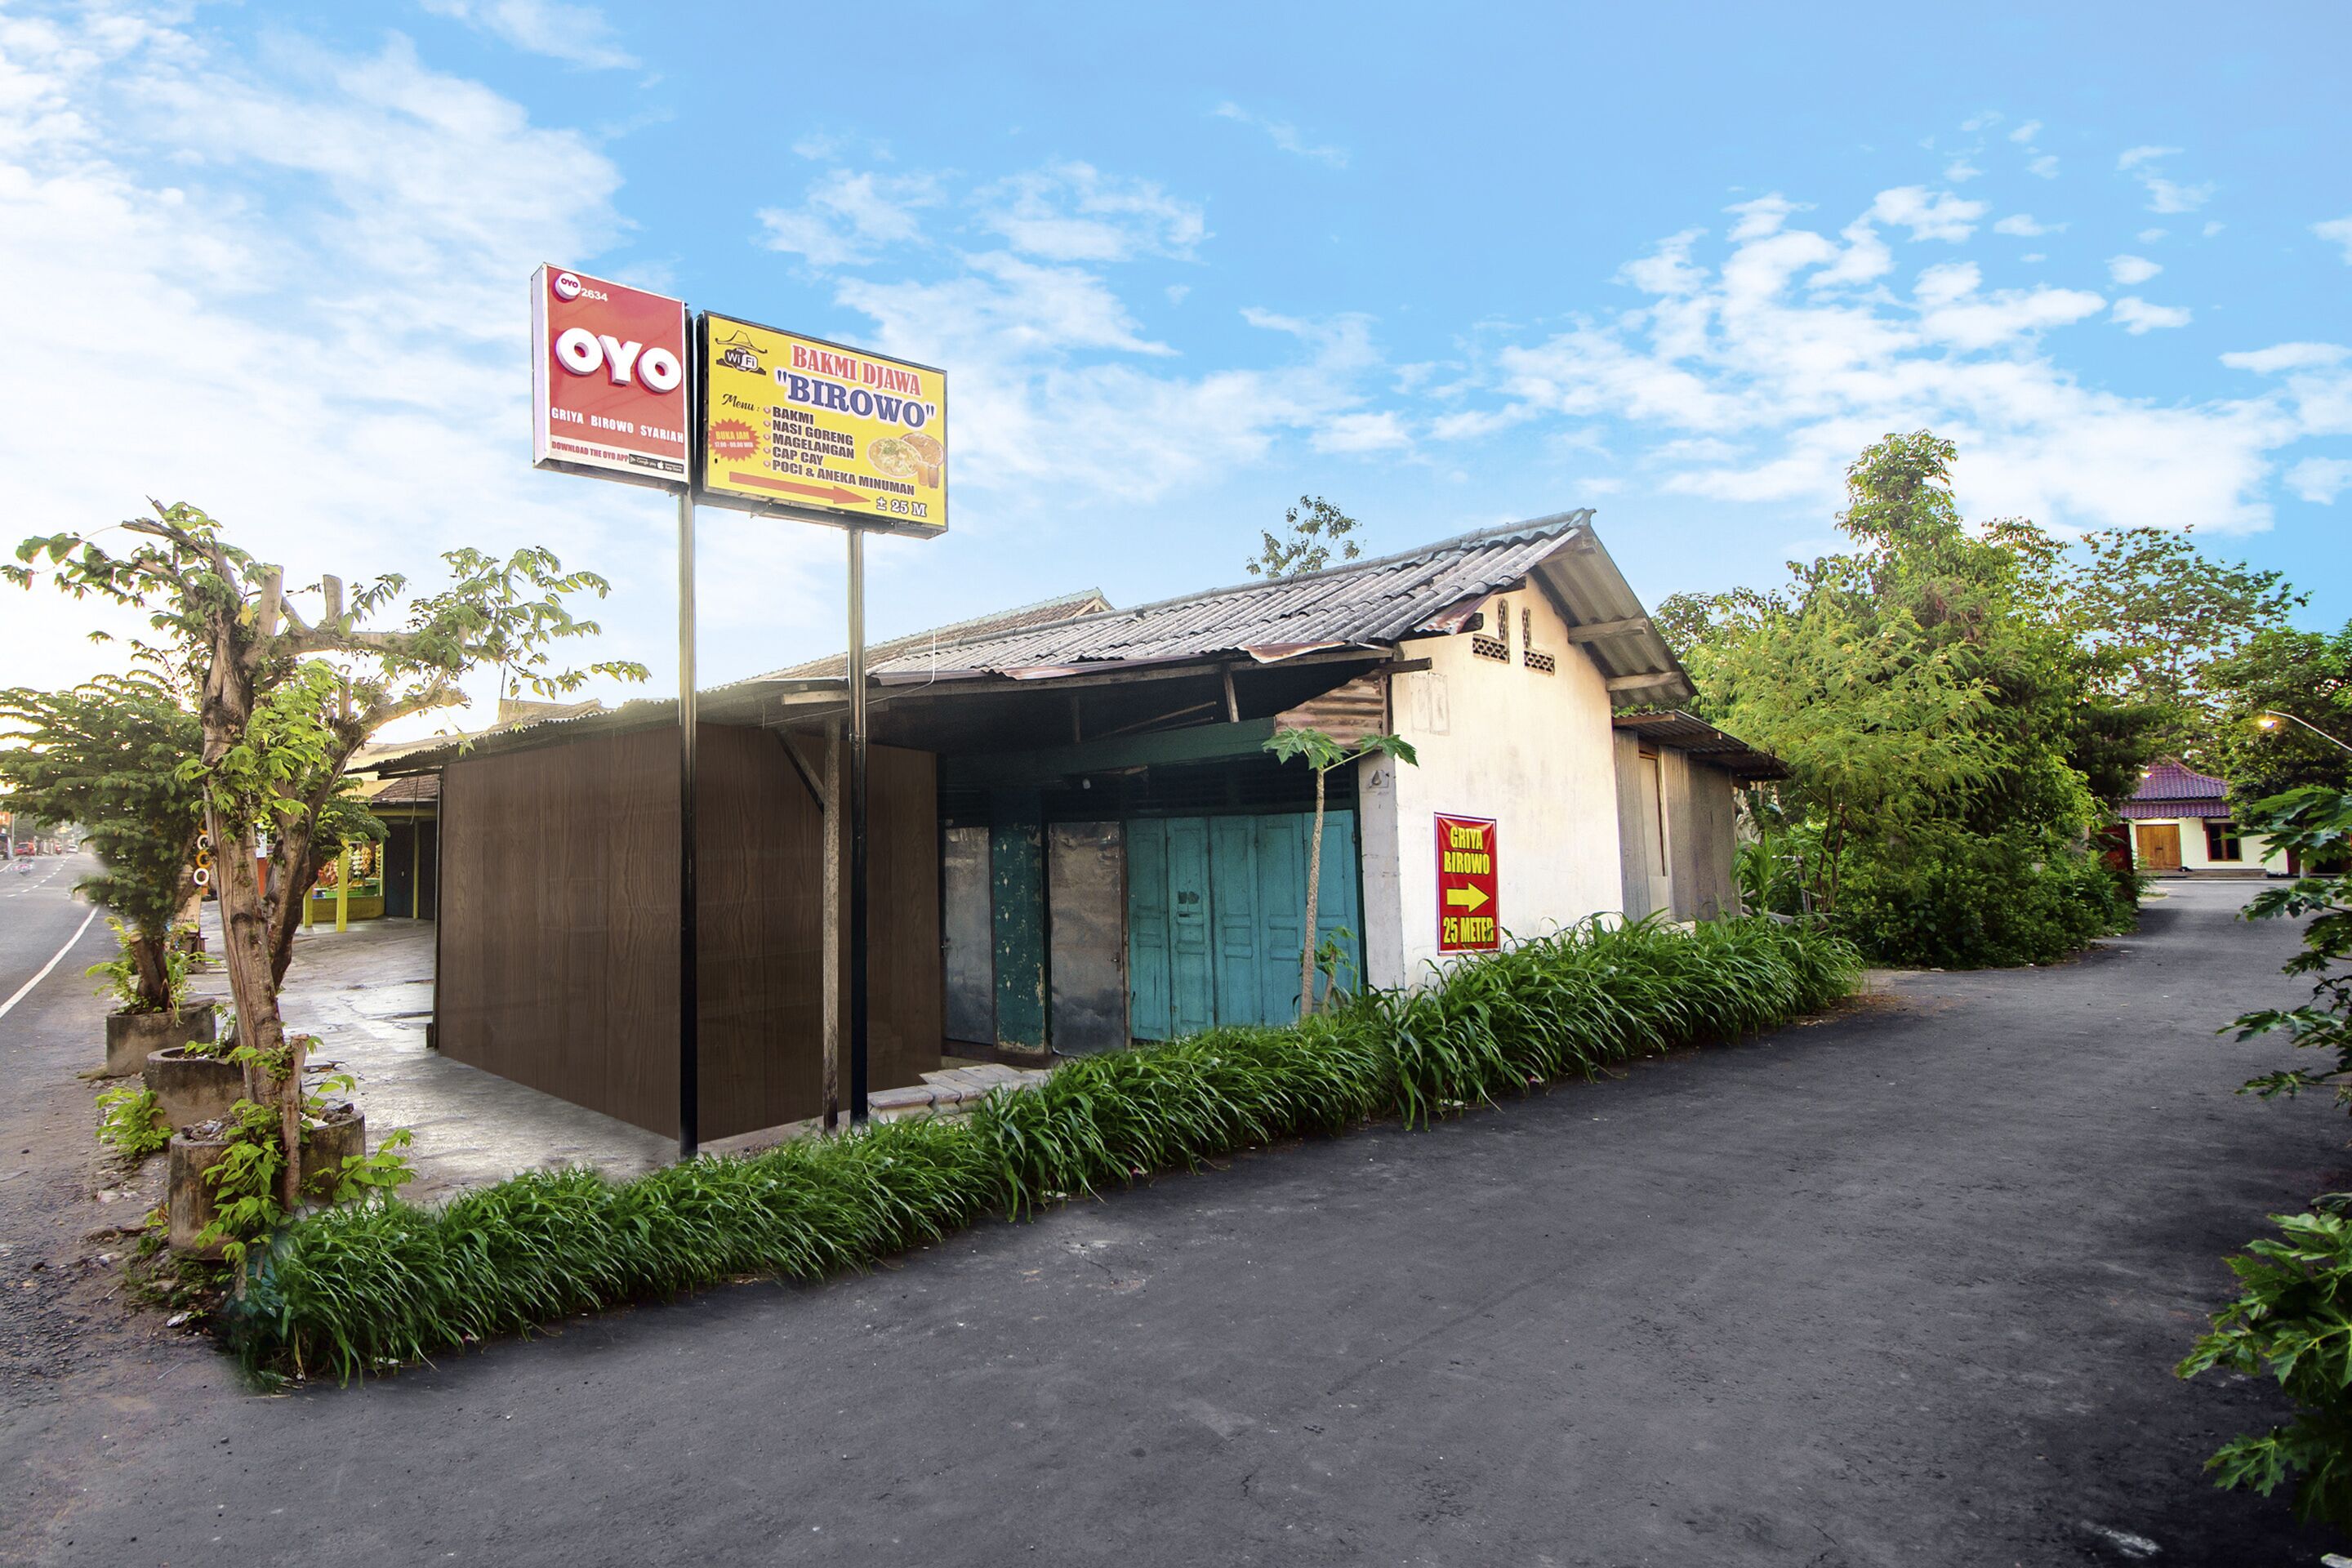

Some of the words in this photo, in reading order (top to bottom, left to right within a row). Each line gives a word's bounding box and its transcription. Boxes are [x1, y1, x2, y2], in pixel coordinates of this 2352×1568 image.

[560, 278, 578, 288] OYO
[581, 287, 608, 302] 2634
[556, 327, 682, 393] OYO
[792, 345, 858, 381] BAKMI
[862, 363, 921, 396] DJAWA
[721, 394, 755, 412] Menu
[777, 370, 935, 428] "BIROWO"
[551, 407, 584, 425] GRIYA
[590, 415, 635, 434] BIROWO
[640, 425, 684, 443] SYARIAH
[772, 406, 814, 425] BAKMI
[715, 431, 736, 440] BUKA
[736, 431, 750, 440] JAM
[772, 420, 802, 435] NASI
[805, 425, 853, 446] GORENG
[551, 441, 589, 456] DOWNLOAD
[590, 448, 602, 458] THE
[772, 433, 855, 459] MAGELANGAN
[772, 446, 798, 461] CAP
[800, 452, 824, 466] CAY
[772, 459, 803, 475] POCI
[805, 466, 815, 477] &
[817, 468, 857, 486] ANEKA
[858, 476, 915, 496] MINUMAN
[891, 500, 908, 514] 25
[911, 501, 928, 518] M
[1450, 826, 1484, 850] GRIYA
[1443, 850, 1490, 875] BIROWO
[1443, 916, 1459, 943] 25
[1460, 916, 1494, 943] METER
